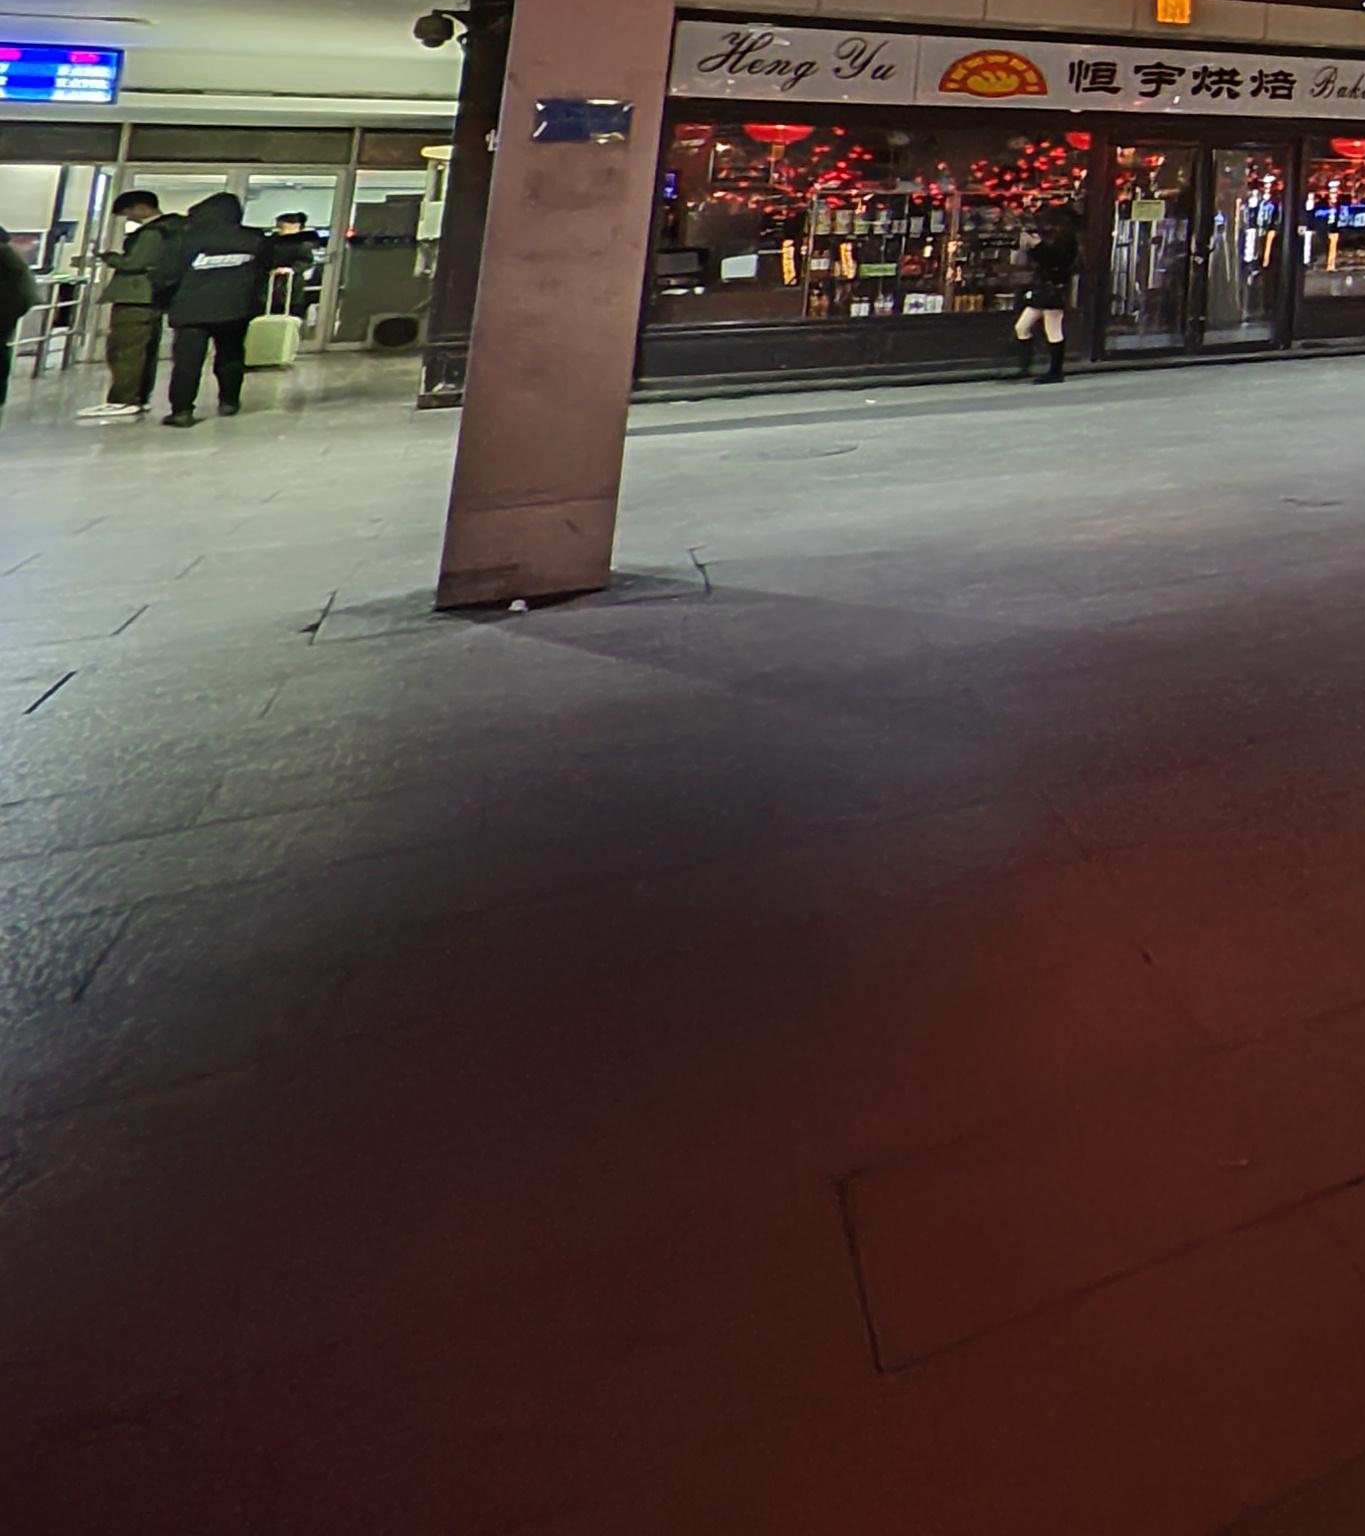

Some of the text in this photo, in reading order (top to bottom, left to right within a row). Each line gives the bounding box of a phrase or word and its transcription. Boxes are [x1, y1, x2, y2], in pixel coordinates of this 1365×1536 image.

[697, 31, 897, 93] Heng Yu
[1068, 59, 1298, 100] 恒宇烘焙
